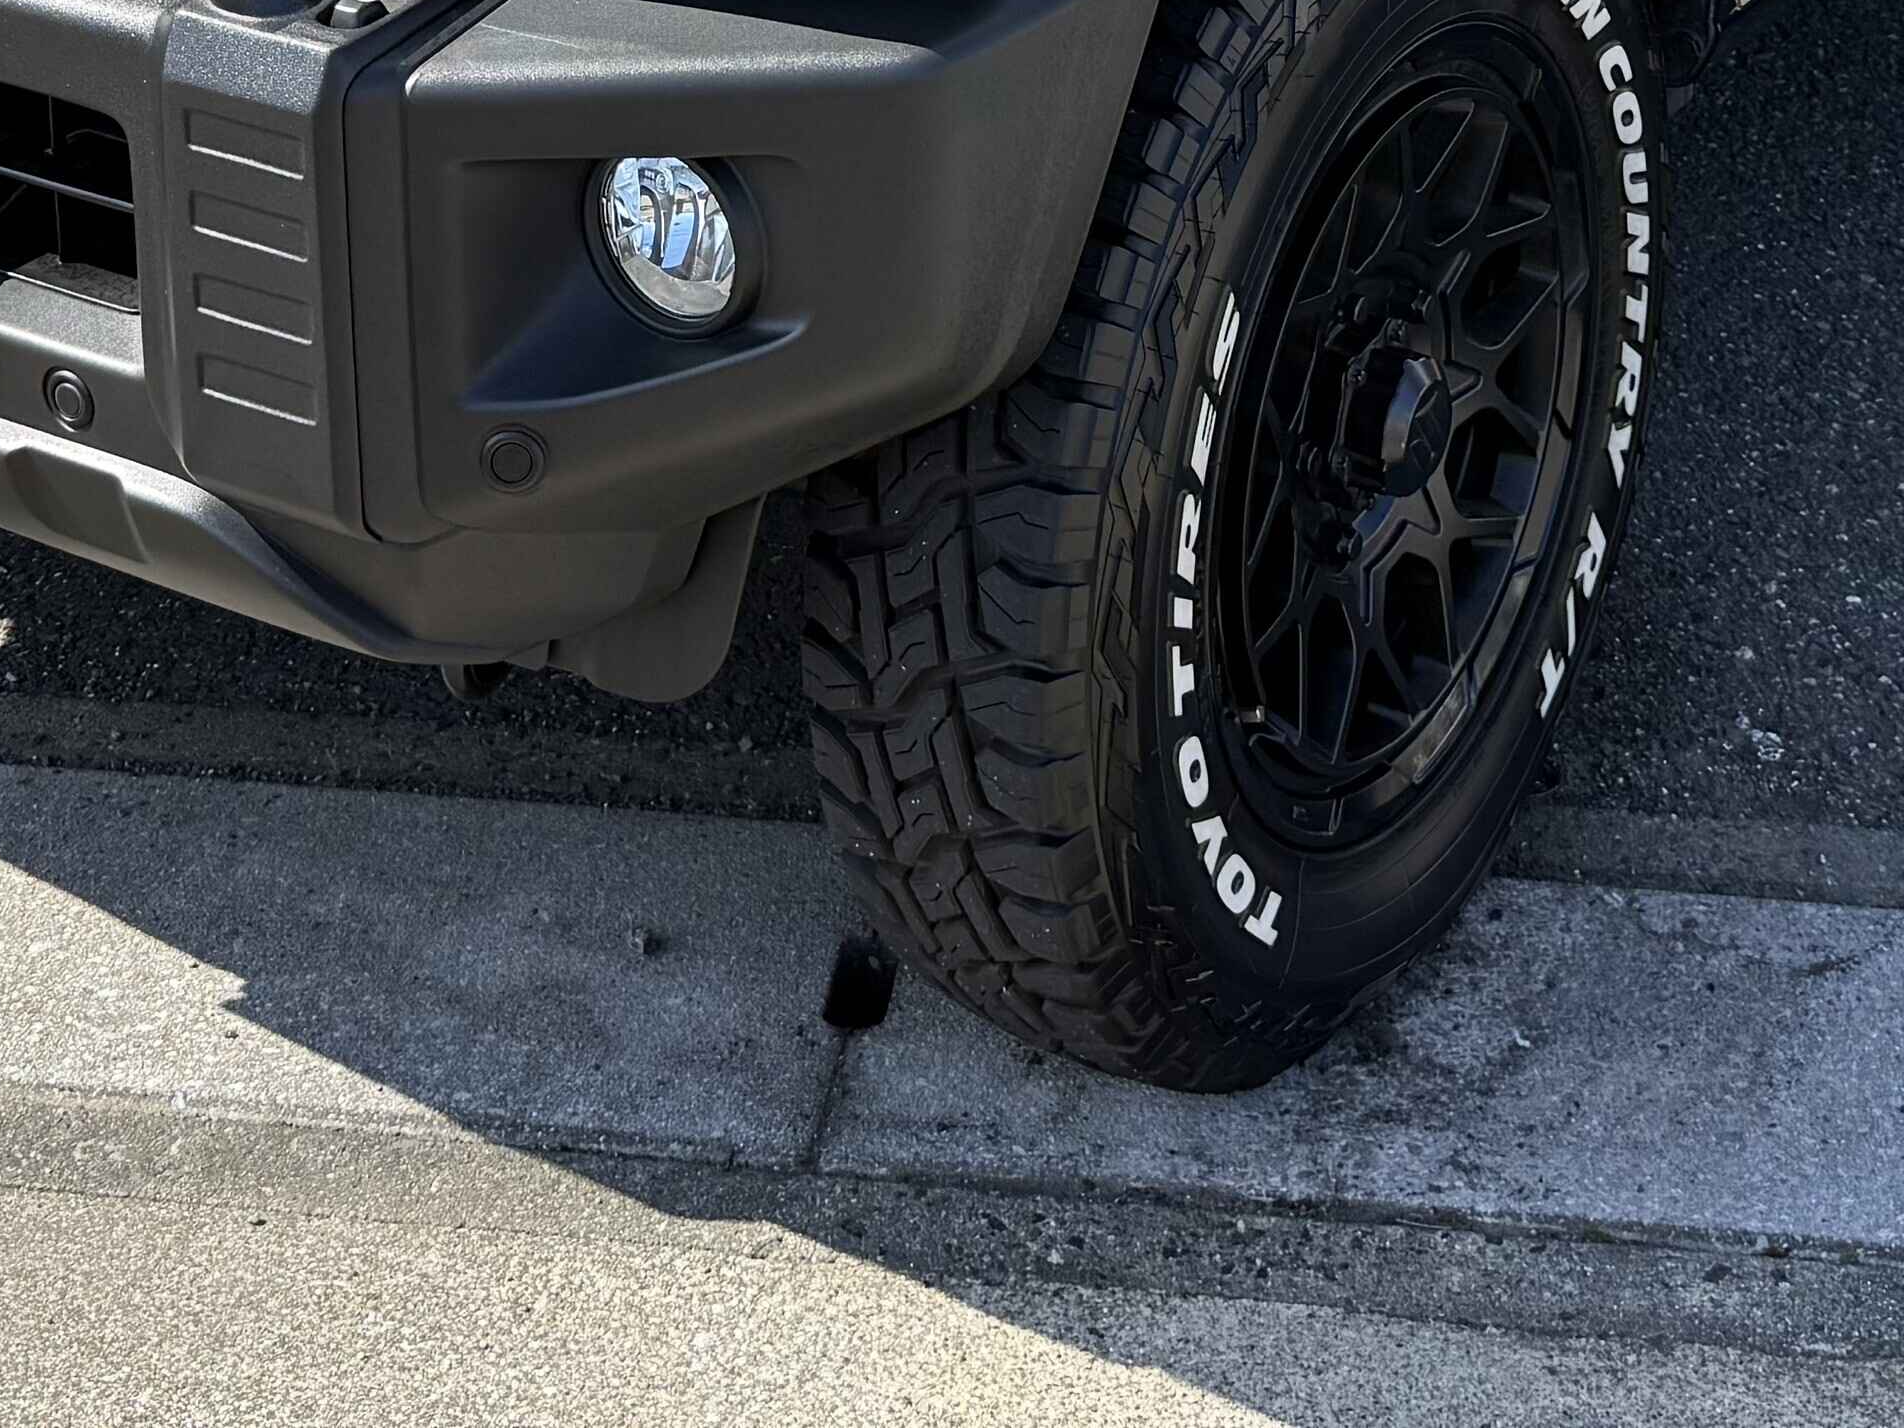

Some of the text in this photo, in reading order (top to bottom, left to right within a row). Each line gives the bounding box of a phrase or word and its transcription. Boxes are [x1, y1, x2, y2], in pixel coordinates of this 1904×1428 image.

[1597, 41, 1654, 488] COUNTRY
[1170, 290, 1283, 948] TOYO TIRES
[1537, 508, 1609, 720] R/T
